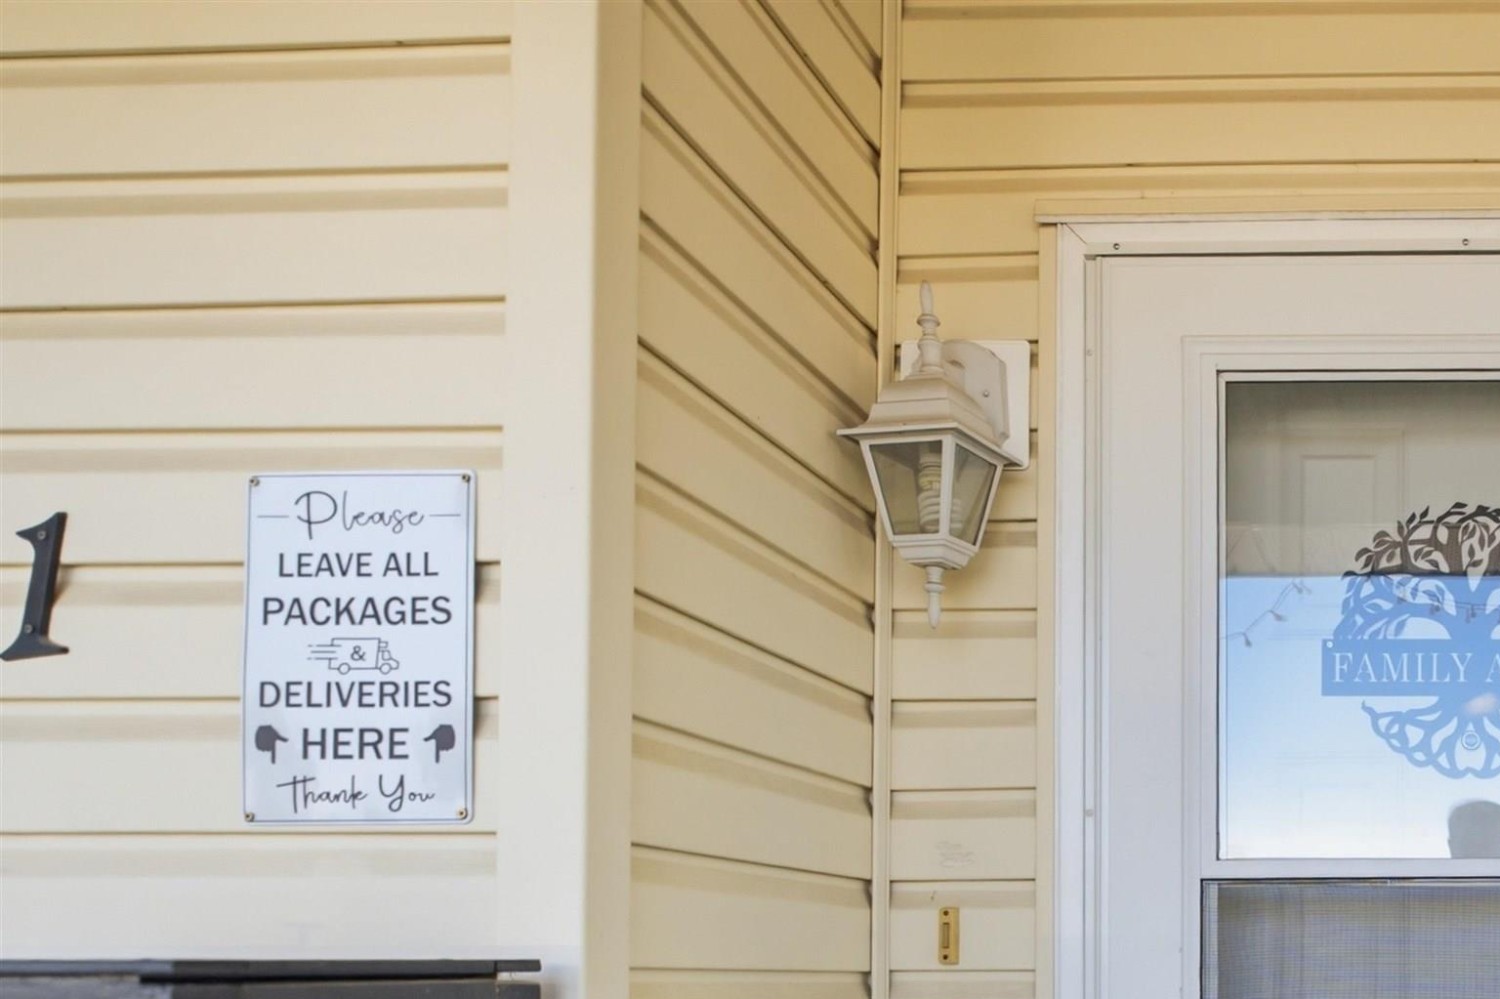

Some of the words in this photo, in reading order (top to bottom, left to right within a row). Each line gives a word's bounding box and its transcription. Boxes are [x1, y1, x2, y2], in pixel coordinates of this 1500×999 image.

[294, 490, 424, 540] Please
[278, 552, 373, 578] LEAVE
[382, 552, 439, 577] ALL
[0, 512, 69, 662] 1
[261, 596, 453, 626] PACKAGES
[350, 645, 367, 662] &
[1332, 652, 1474, 684] FAMILY
[259, 681, 453, 709] DELIVERIES
[302, 727, 410, 760] HERE
[276, 775, 368, 814] Thank
[379, 774, 436, 813] You
